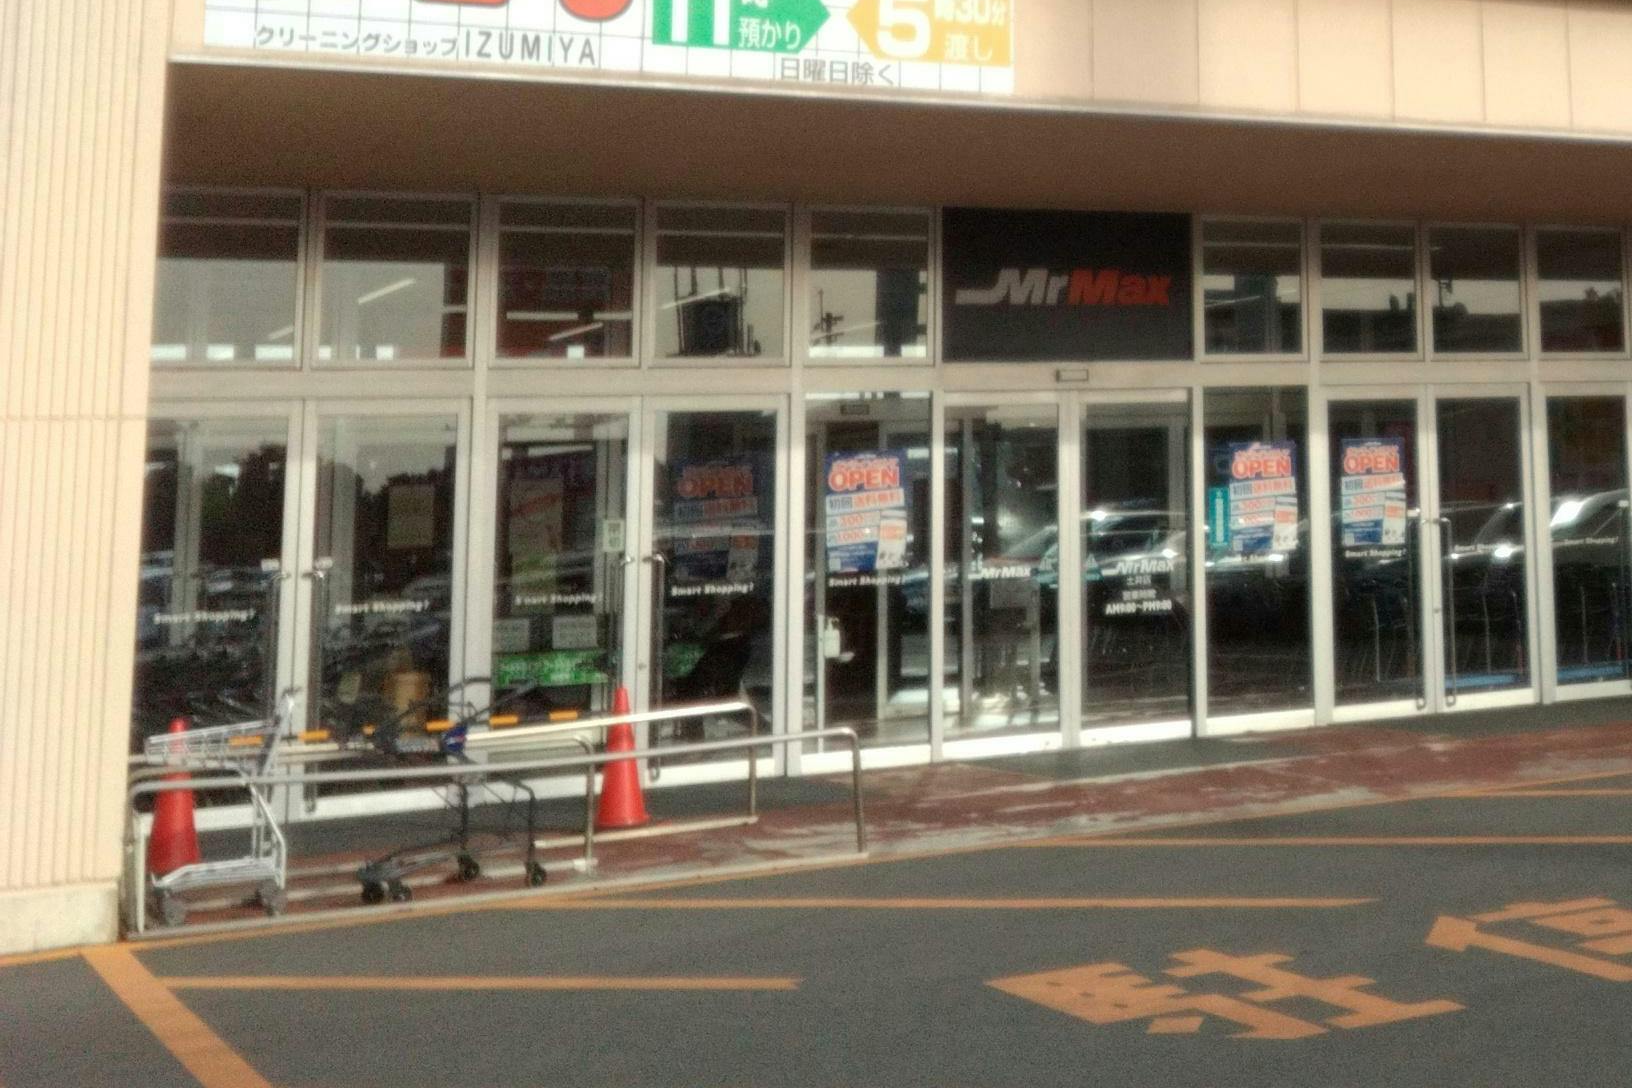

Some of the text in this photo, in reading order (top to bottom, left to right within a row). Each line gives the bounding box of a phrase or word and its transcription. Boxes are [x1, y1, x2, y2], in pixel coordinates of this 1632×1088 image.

[463, 31, 598, 66] IZUMIYA
[780, 58, 897, 86] 日曜日除く
[1232, 457, 1292, 480] OPEN
[1343, 451, 1400, 475] OPEN
[829, 468, 900, 493] OPEN
